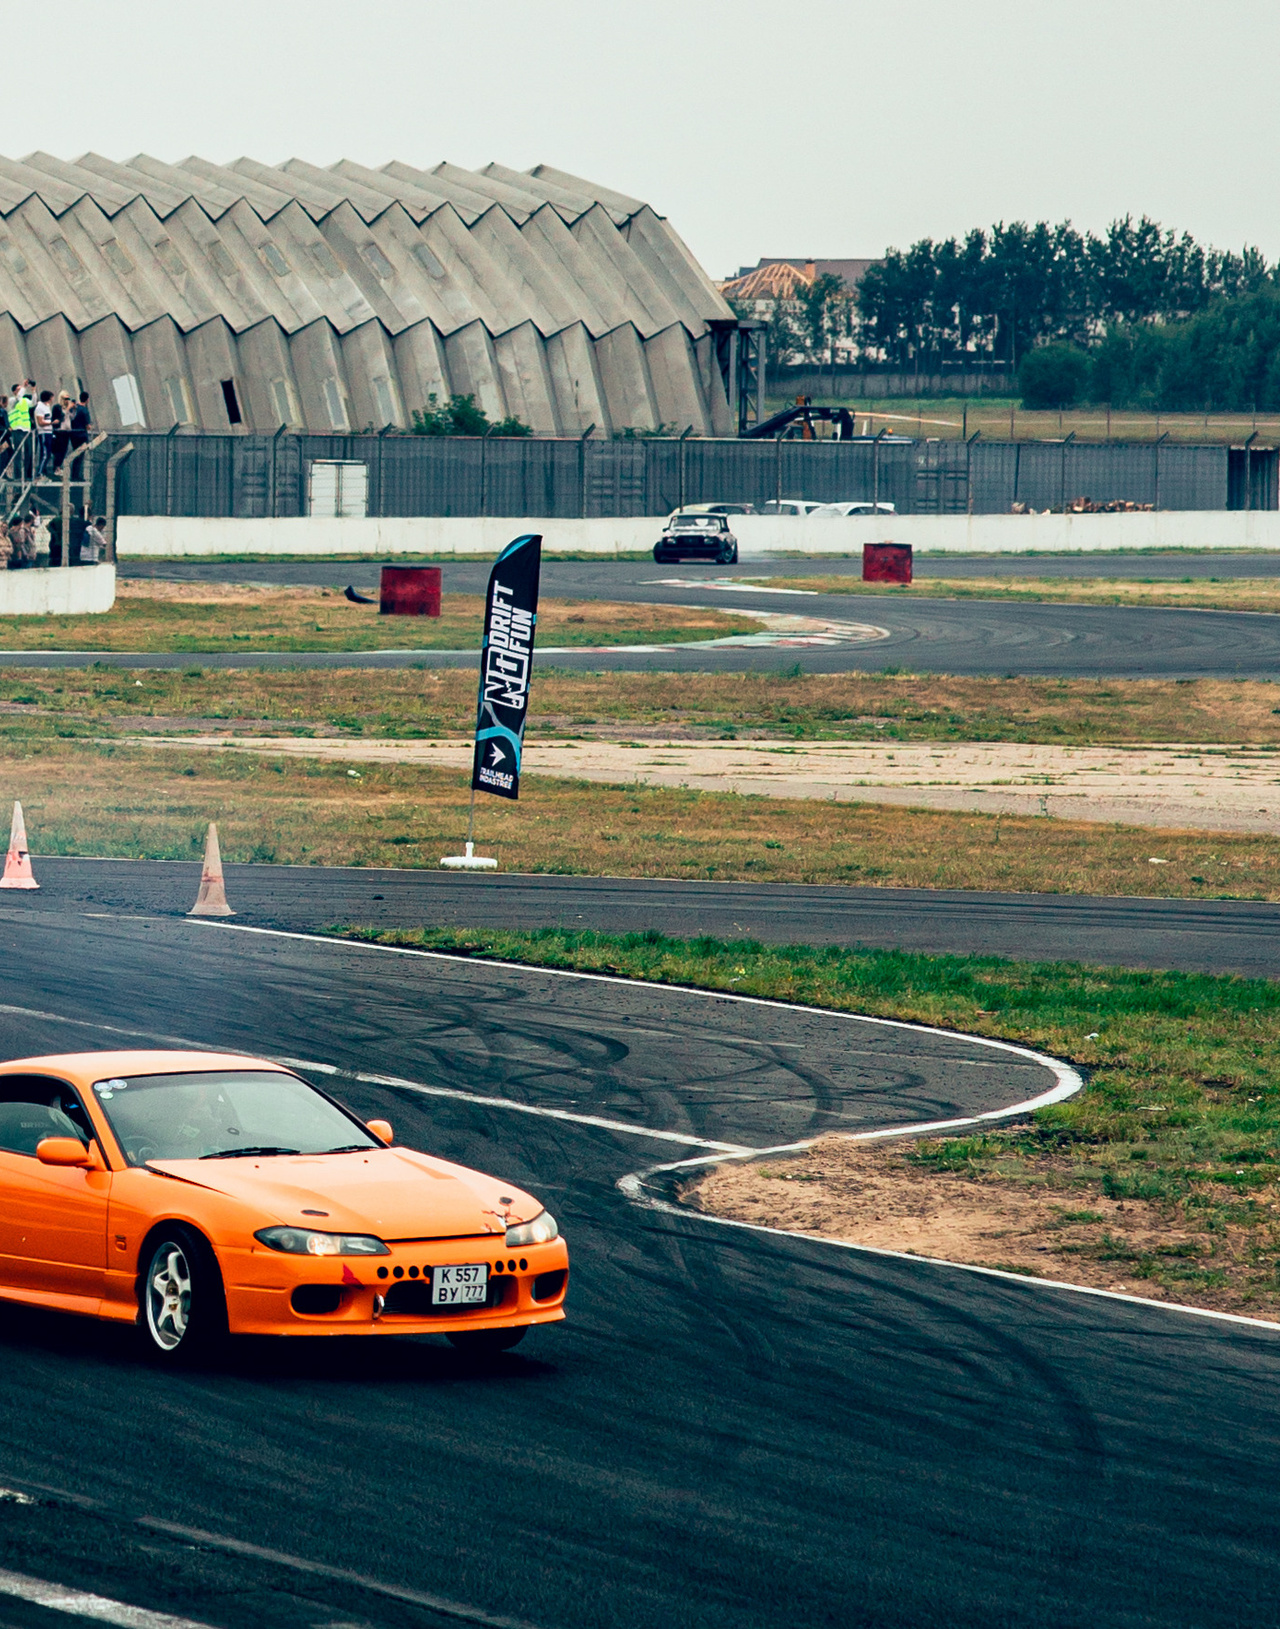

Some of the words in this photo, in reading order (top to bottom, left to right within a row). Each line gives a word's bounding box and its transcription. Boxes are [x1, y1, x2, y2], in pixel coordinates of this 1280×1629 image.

[488, 580, 514, 649] DRIFT
[509, 607, 532, 655] FUN
[441, 1269, 451, 1283] K
[455, 1267, 479, 1283] 557
[464, 1285, 484, 1298] 777
